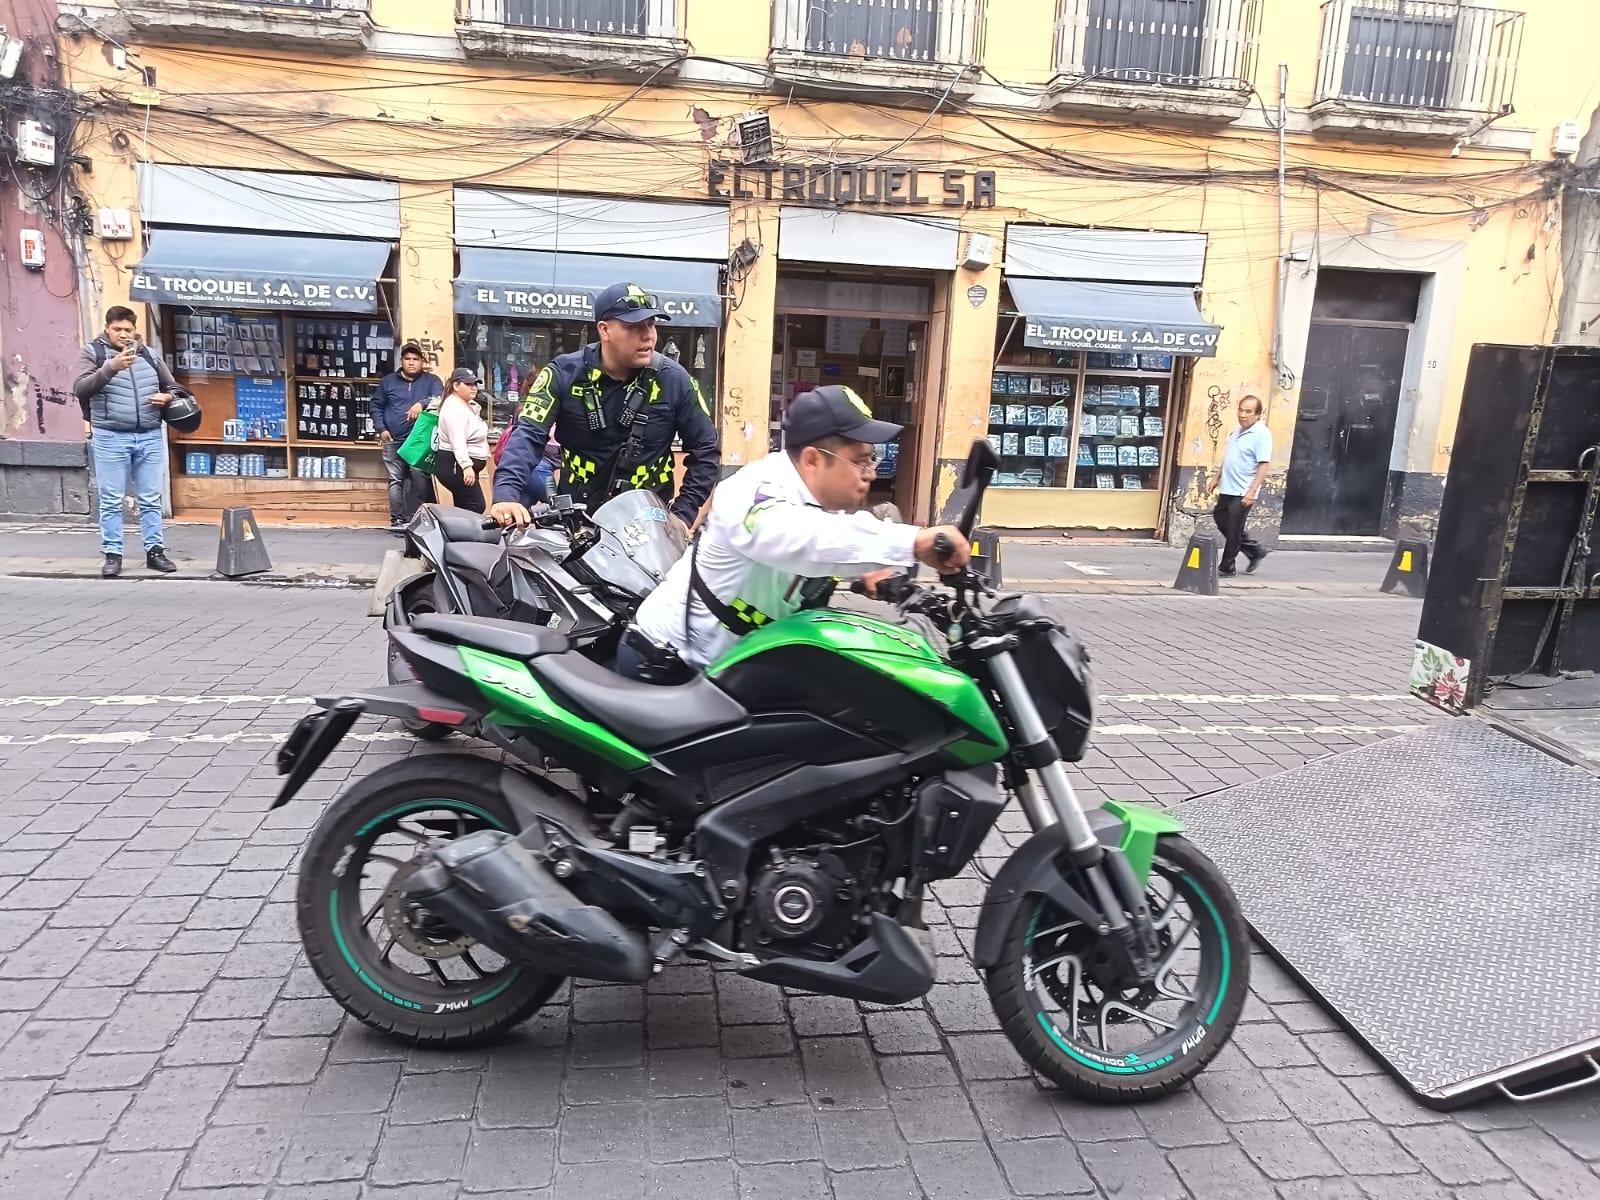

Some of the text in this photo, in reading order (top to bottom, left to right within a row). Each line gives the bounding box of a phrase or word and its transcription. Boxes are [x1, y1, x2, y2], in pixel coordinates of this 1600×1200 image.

[133, 275, 375, 301] EL TROQUEL S.A. DE C.V.
[477, 288, 700, 315] EL TROQUEL C.V.
[1027, 323, 1219, 347] EL TROQUEL S.A. DE C.V.
